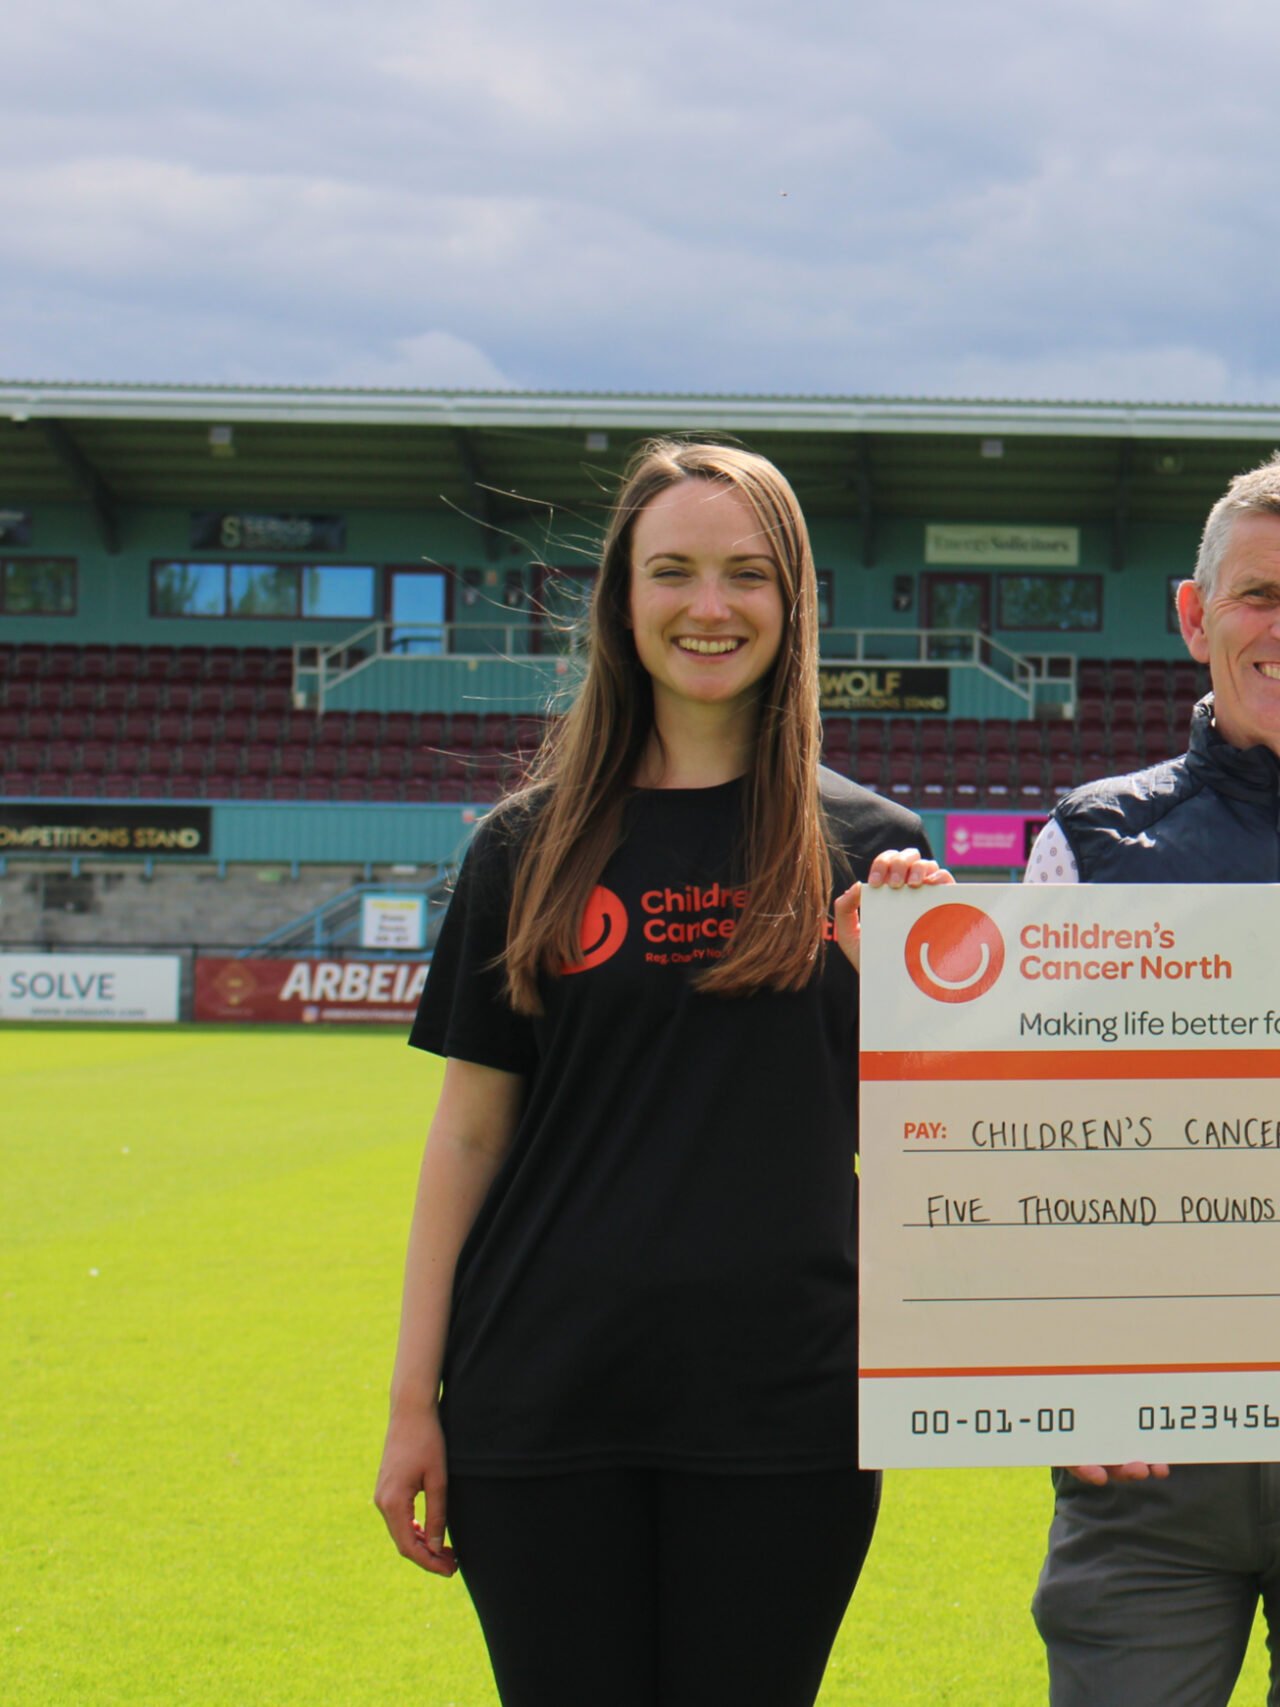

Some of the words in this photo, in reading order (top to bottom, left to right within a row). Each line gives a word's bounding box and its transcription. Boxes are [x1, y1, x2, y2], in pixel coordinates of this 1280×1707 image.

[819, 671, 902, 697] WOLF
[133, 826, 201, 849] STAND
[641, 883, 750, 914] Childre
[643, 917, 736, 943] Cance
[1019, 921, 1176, 950] Children's
[645, 952, 669, 965] Reg.
[1019, 954, 1135, 981] Cancer
[1140, 953, 1233, 980] North
[9, 971, 116, 1000] SOLVE
[279, 961, 431, 1003] ARBEIA
[1019, 1011, 1119, 1043] Making
[1124, 1010, 1165, 1037] life
[1171, 1010, 1259, 1036] better
[903, 1121, 947, 1140] PAY:
[971, 1116, 1154, 1150] CHILDREN'S
[927, 1194, 991, 1228] FIVE
[1019, 1194, 1157, 1227] THOUSAND
[1180, 1195, 1277, 1224] POUNDS
[911, 1407, 1075, 1436] 00-01-00
